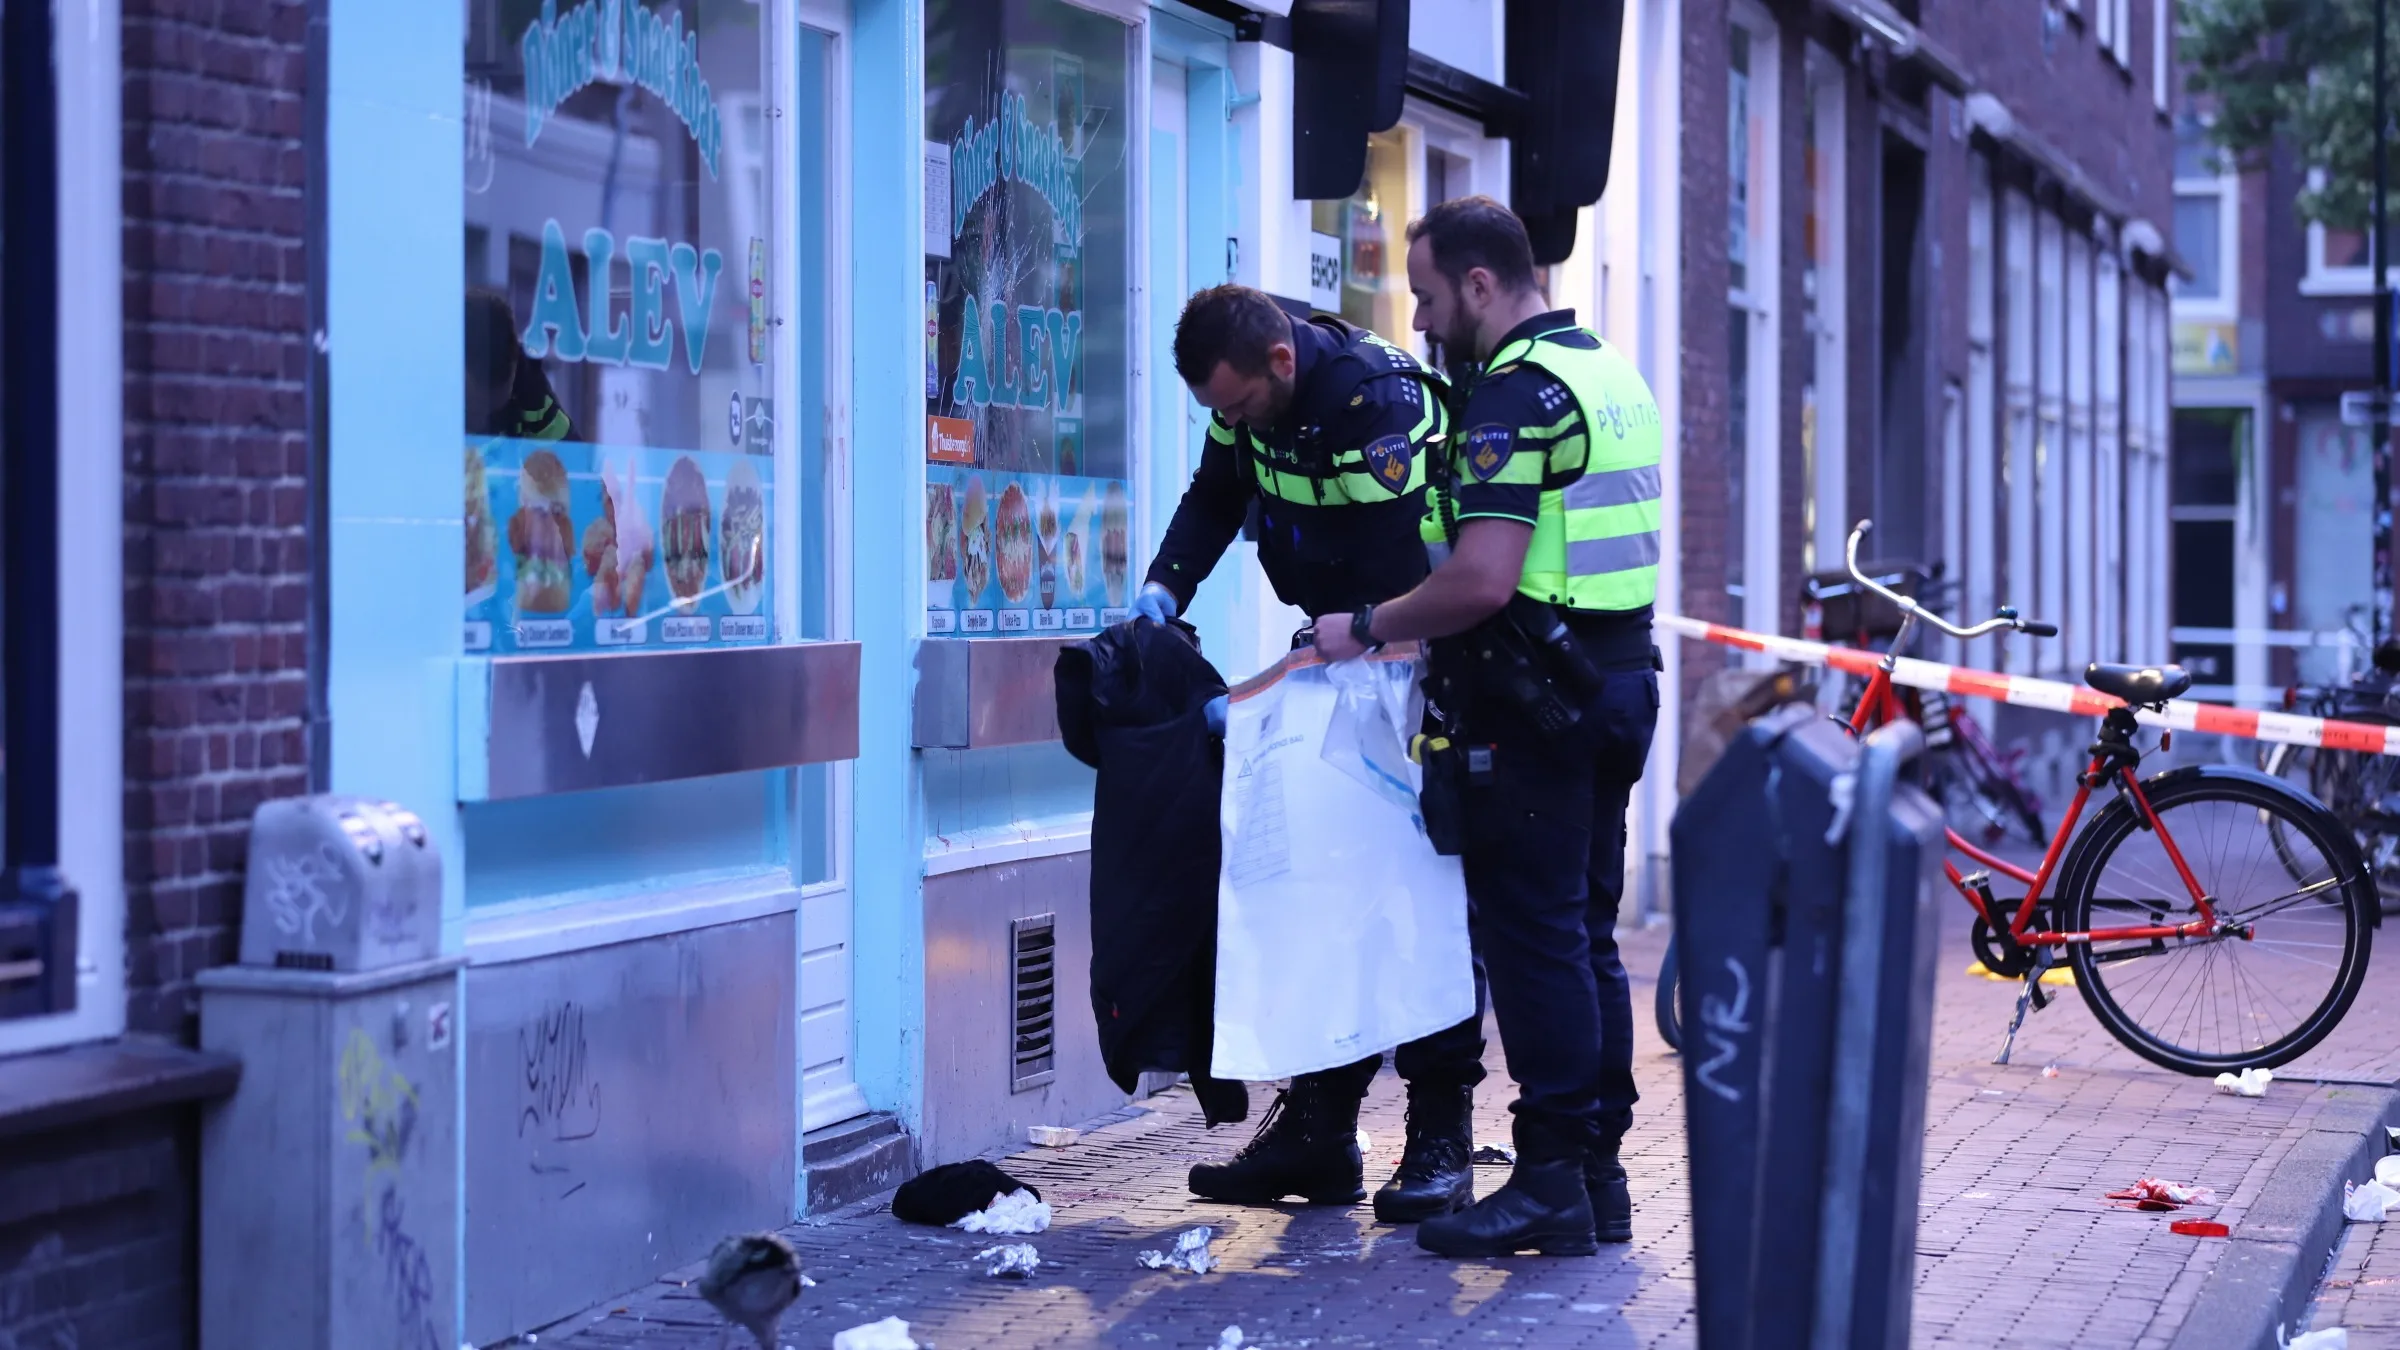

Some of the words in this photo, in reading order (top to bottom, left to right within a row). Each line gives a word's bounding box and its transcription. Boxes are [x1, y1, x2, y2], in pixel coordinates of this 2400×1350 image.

[623, 0, 721, 182] Snackbar
[1001, 89, 1014, 182] &
[1015, 93, 1081, 259] Snackbar
[523, 218, 722, 374] ALEV
[953, 294, 1081, 411] ALEV
[1371, 441, 1405, 457] POLITIE
[1470, 432, 1509, 443] POLITIE
